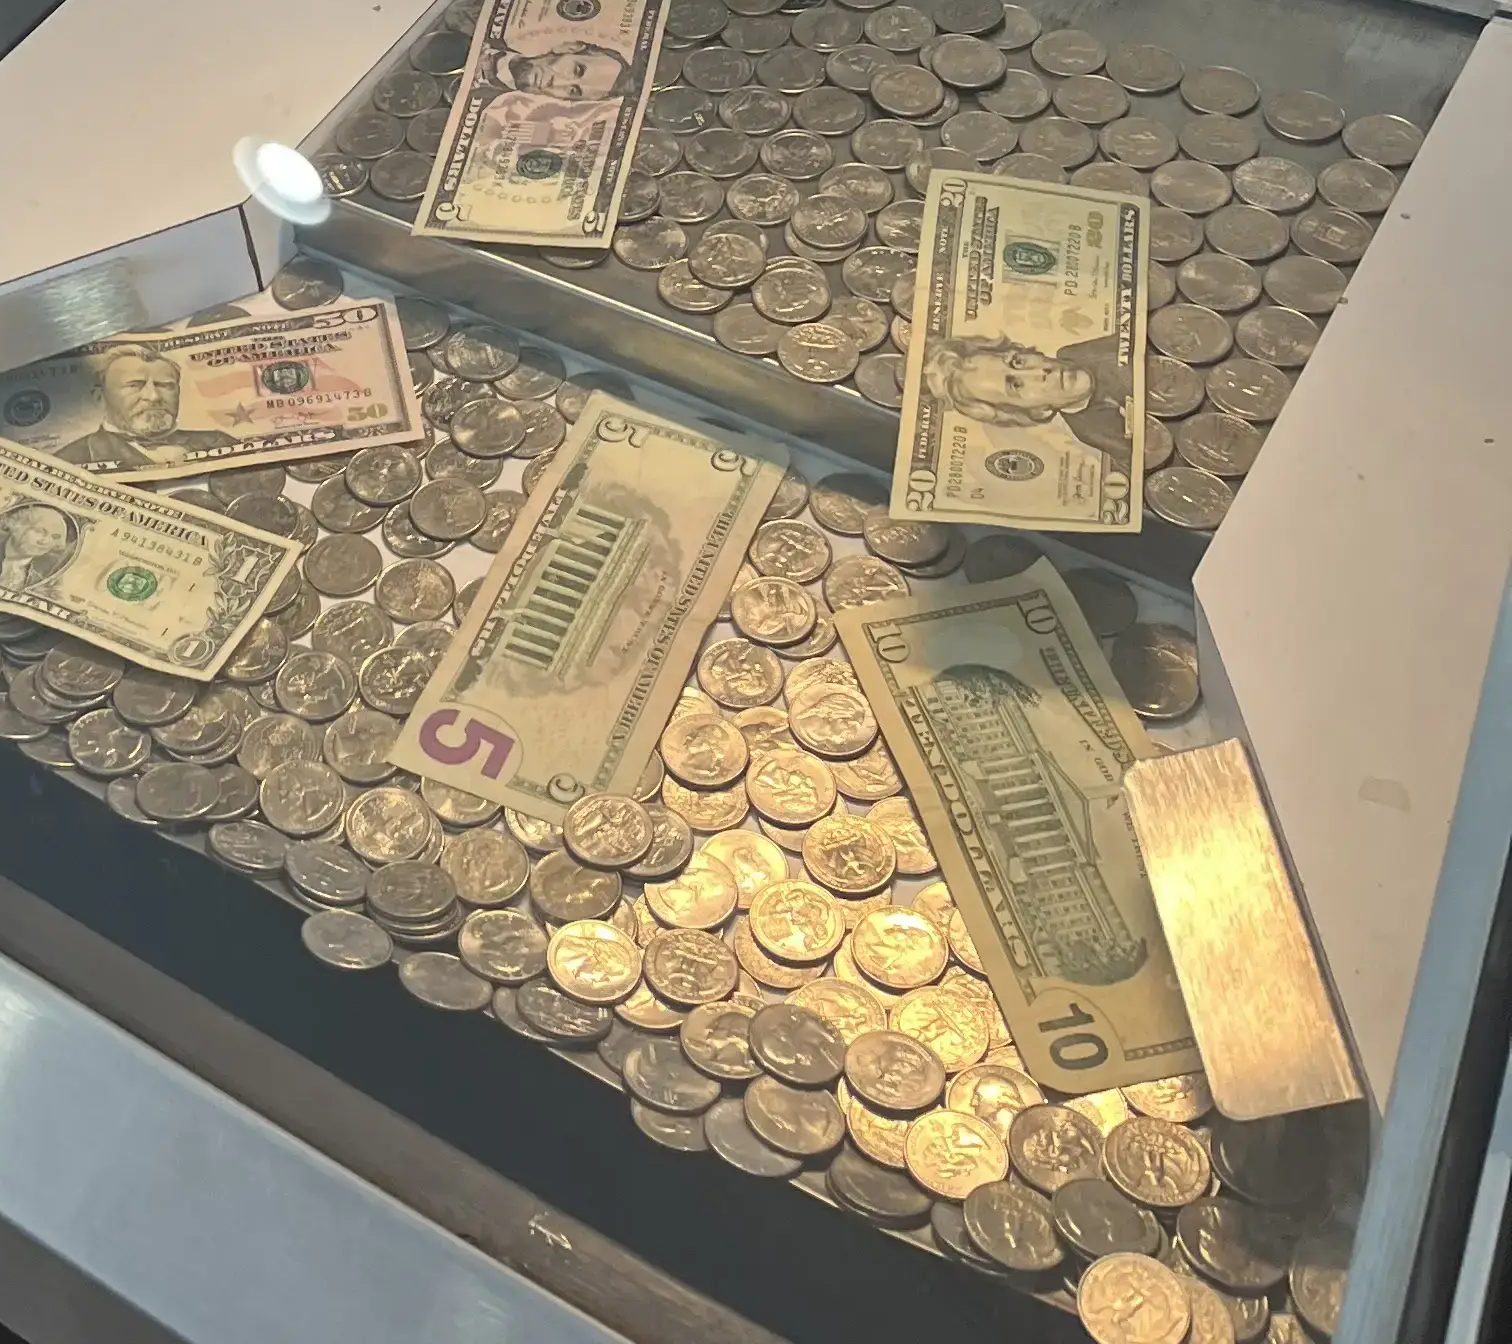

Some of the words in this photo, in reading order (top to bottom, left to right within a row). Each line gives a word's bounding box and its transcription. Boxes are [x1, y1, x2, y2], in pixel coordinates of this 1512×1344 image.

[442, 97, 482, 190] DOLLARS
[940, 176, 967, 208] 20
[938, 225, 948, 253] NOTE
[1086, 210, 1103, 248] 20
[1121, 208, 1135, 282] DOLLARS
[311, 306, 379, 329] 50
[1118, 286, 1131, 367] TWENTY
[188, 341, 266, 362] UNITED
[268, 328, 353, 351] STATES
[237, 339, 342, 367] AMERICA
[343, 400, 390, 424] 50
[590, 414, 651, 452] 5
[185, 428, 336, 460] DOLLARS
[706, 447, 759, 481] 5
[29, 476, 98, 506] STATES
[97, 500, 127, 517] OF
[122, 509, 213, 547] AMERICA
[132, 498, 180, 517] NOTE
[905, 469, 937, 511] 20
[1101, 471, 1130, 524] 20
[709, 509, 734, 542] THE
[229, 552, 263, 584] 1
[683, 541, 719, 596] UNITED
[466, 543, 537, 657] DOLLARS
[655, 596, 692, 646] STATES
[1015, 593, 1060, 637] 10
[643, 646, 666, 671] OF
[865, 618, 915, 667] 10
[611, 668, 655, 743] AMERICA
[1061, 685, 1123, 750] UNITED
[419, 708, 516, 780] 5
[1078, 739, 1095, 752] IN
[1093, 756, 1115, 782] GOD
[902, 699, 944, 767] TEN
[933, 770, 1034, 968] DOLLARS
[1038, 1002, 1109, 1071] 10
